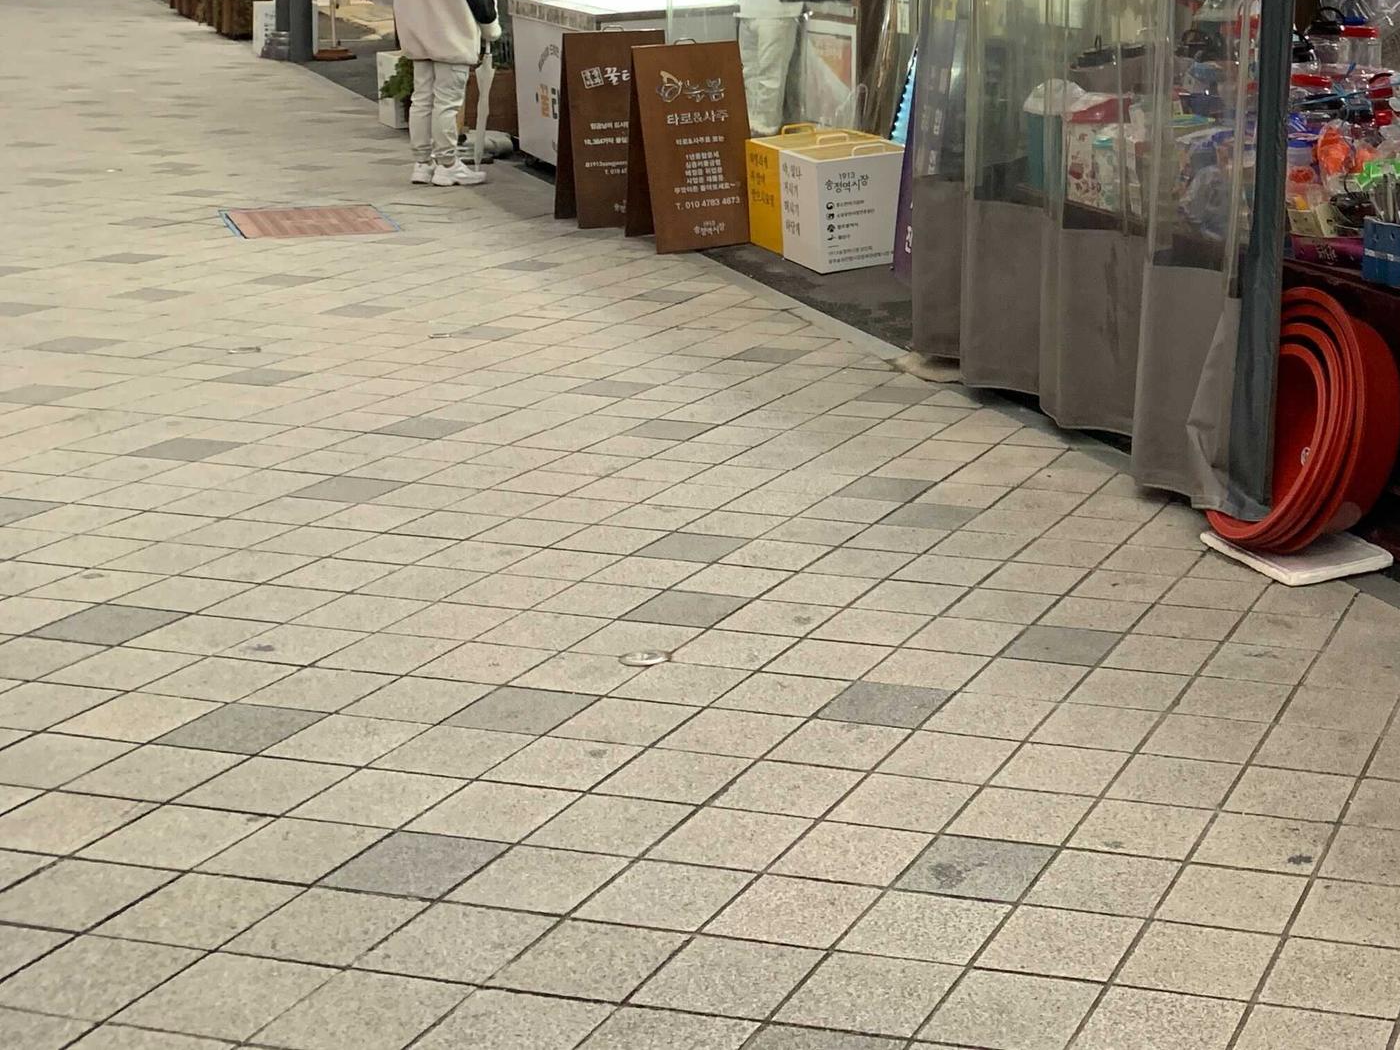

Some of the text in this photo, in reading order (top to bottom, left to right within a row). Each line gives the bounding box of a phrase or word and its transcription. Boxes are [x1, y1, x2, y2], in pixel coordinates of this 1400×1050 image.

[667, 110, 729, 126] 타로&사주
[838, 171, 856, 180] 1913
[825, 173, 870, 194] 송정역시장
[685, 200, 700, 210] 010
